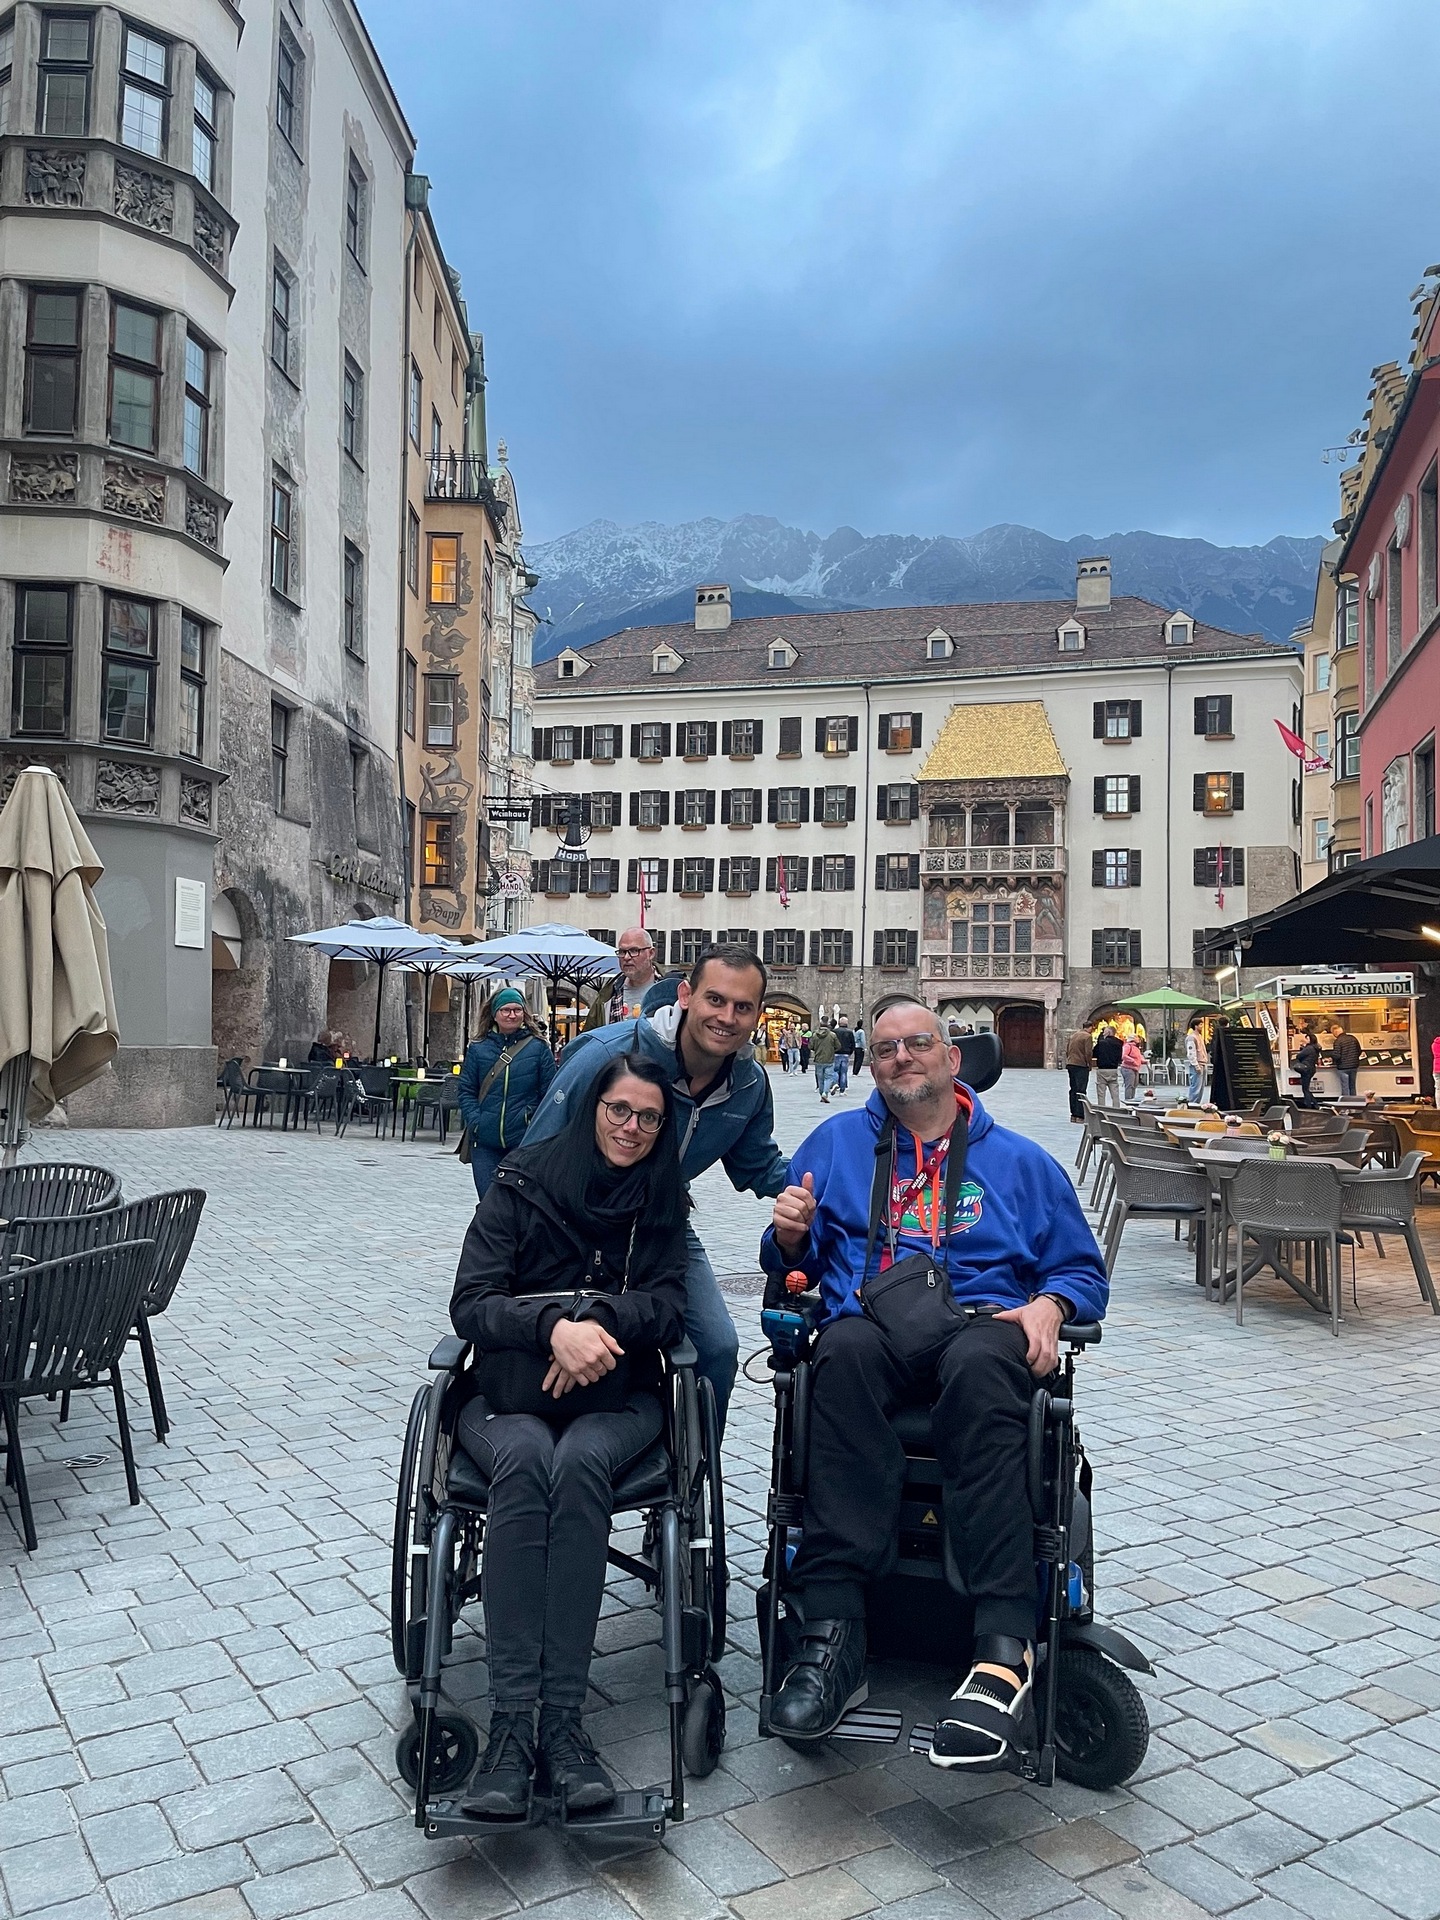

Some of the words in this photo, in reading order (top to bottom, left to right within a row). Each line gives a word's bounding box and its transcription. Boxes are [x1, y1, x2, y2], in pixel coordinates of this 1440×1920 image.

[491, 809, 526, 818] Weinhaus
[558, 851, 585, 861] Happ
[500, 881, 523, 891] HANDL
[1300, 983, 1410, 996] ALTSTADTSTANDL
[1260, 1011, 1276, 1039] HOTDOG
[911, 1172, 925, 1190] MIAMI
[917, 1172, 928, 1190] HEAT
